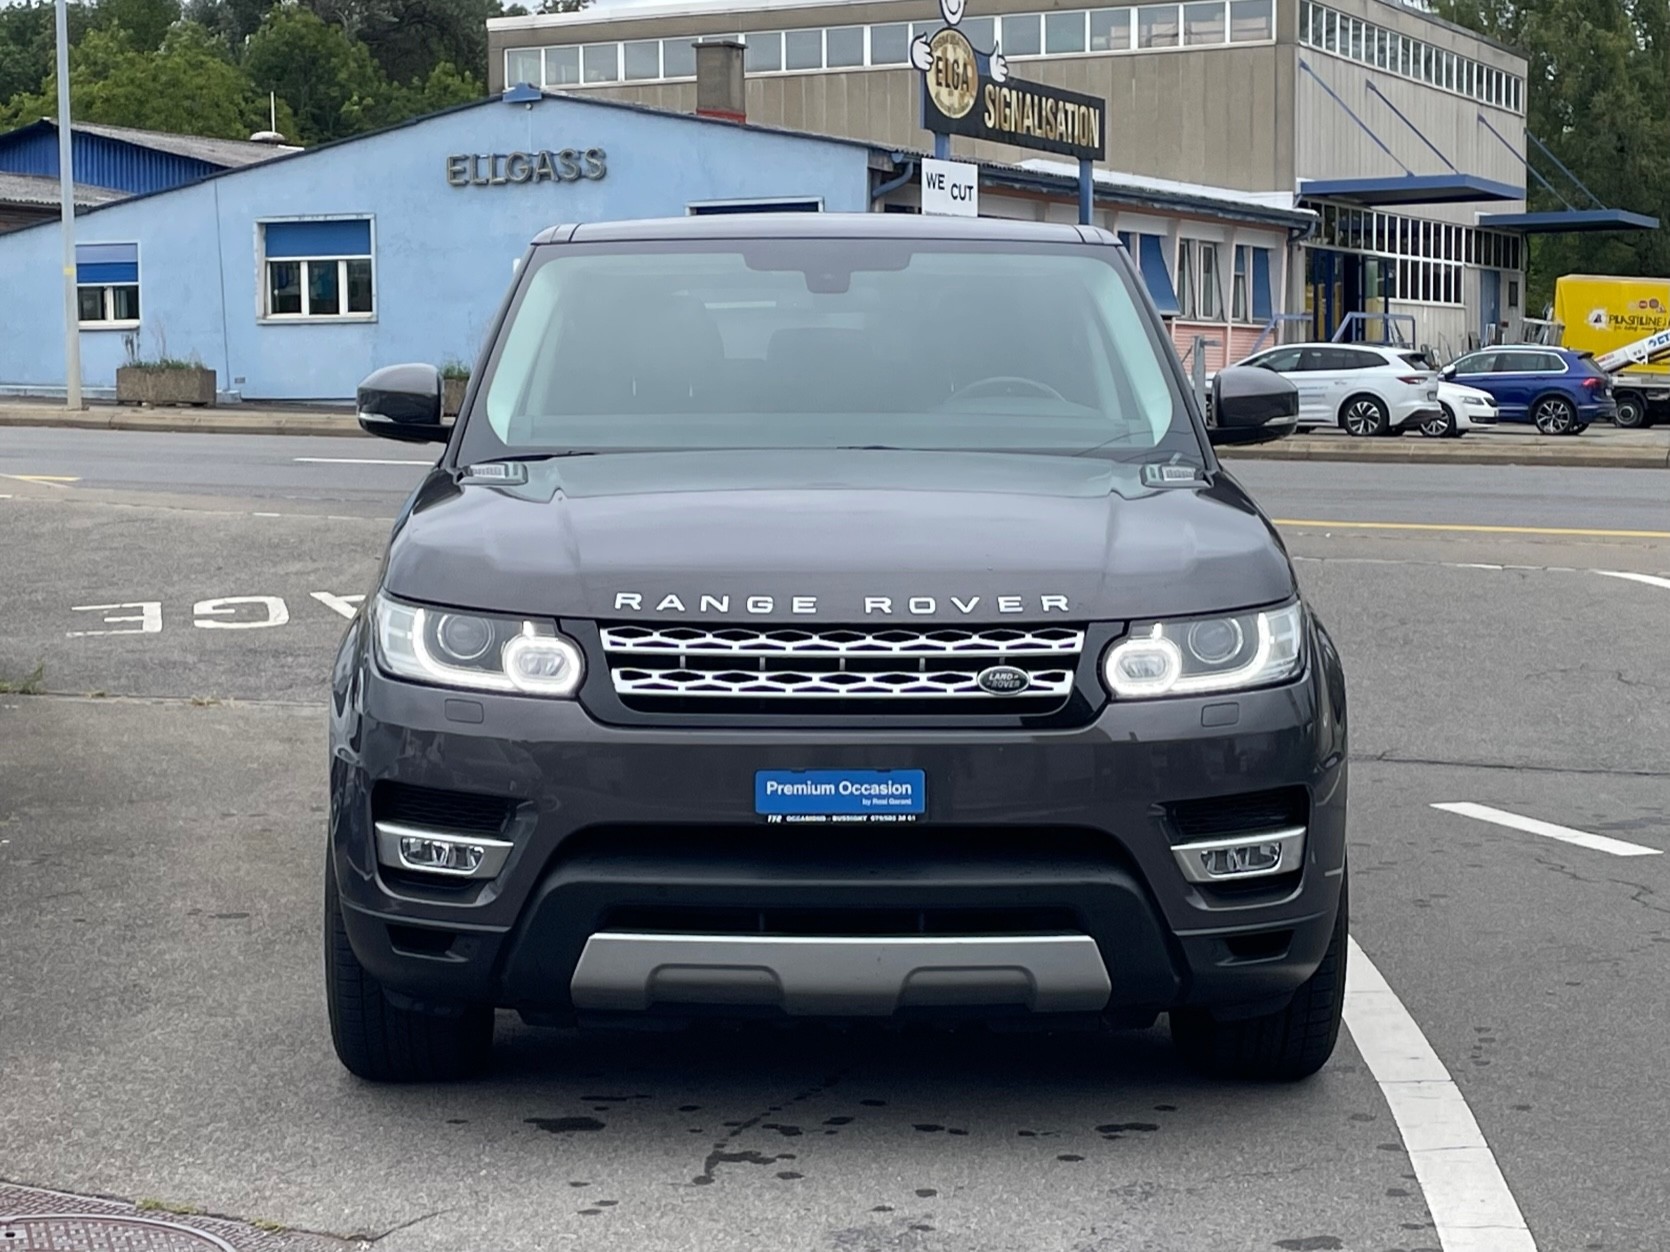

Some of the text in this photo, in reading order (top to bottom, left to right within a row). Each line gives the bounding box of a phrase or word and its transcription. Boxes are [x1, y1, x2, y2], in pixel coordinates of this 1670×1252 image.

[935, 55, 969, 93] ELGA
[984, 84, 1100, 149] SIGNALISATION
[447, 148, 607, 186] ELLGASS
[926, 172, 974, 202] WE CUT
[614, 592, 1070, 614] RANGE ROVER
[989, 672, 1013, 681] LAND
[991, 680, 1021, 688] ROVER
[766, 780, 912, 796] Premium Occasion
[862, 797, 871, 807] by
